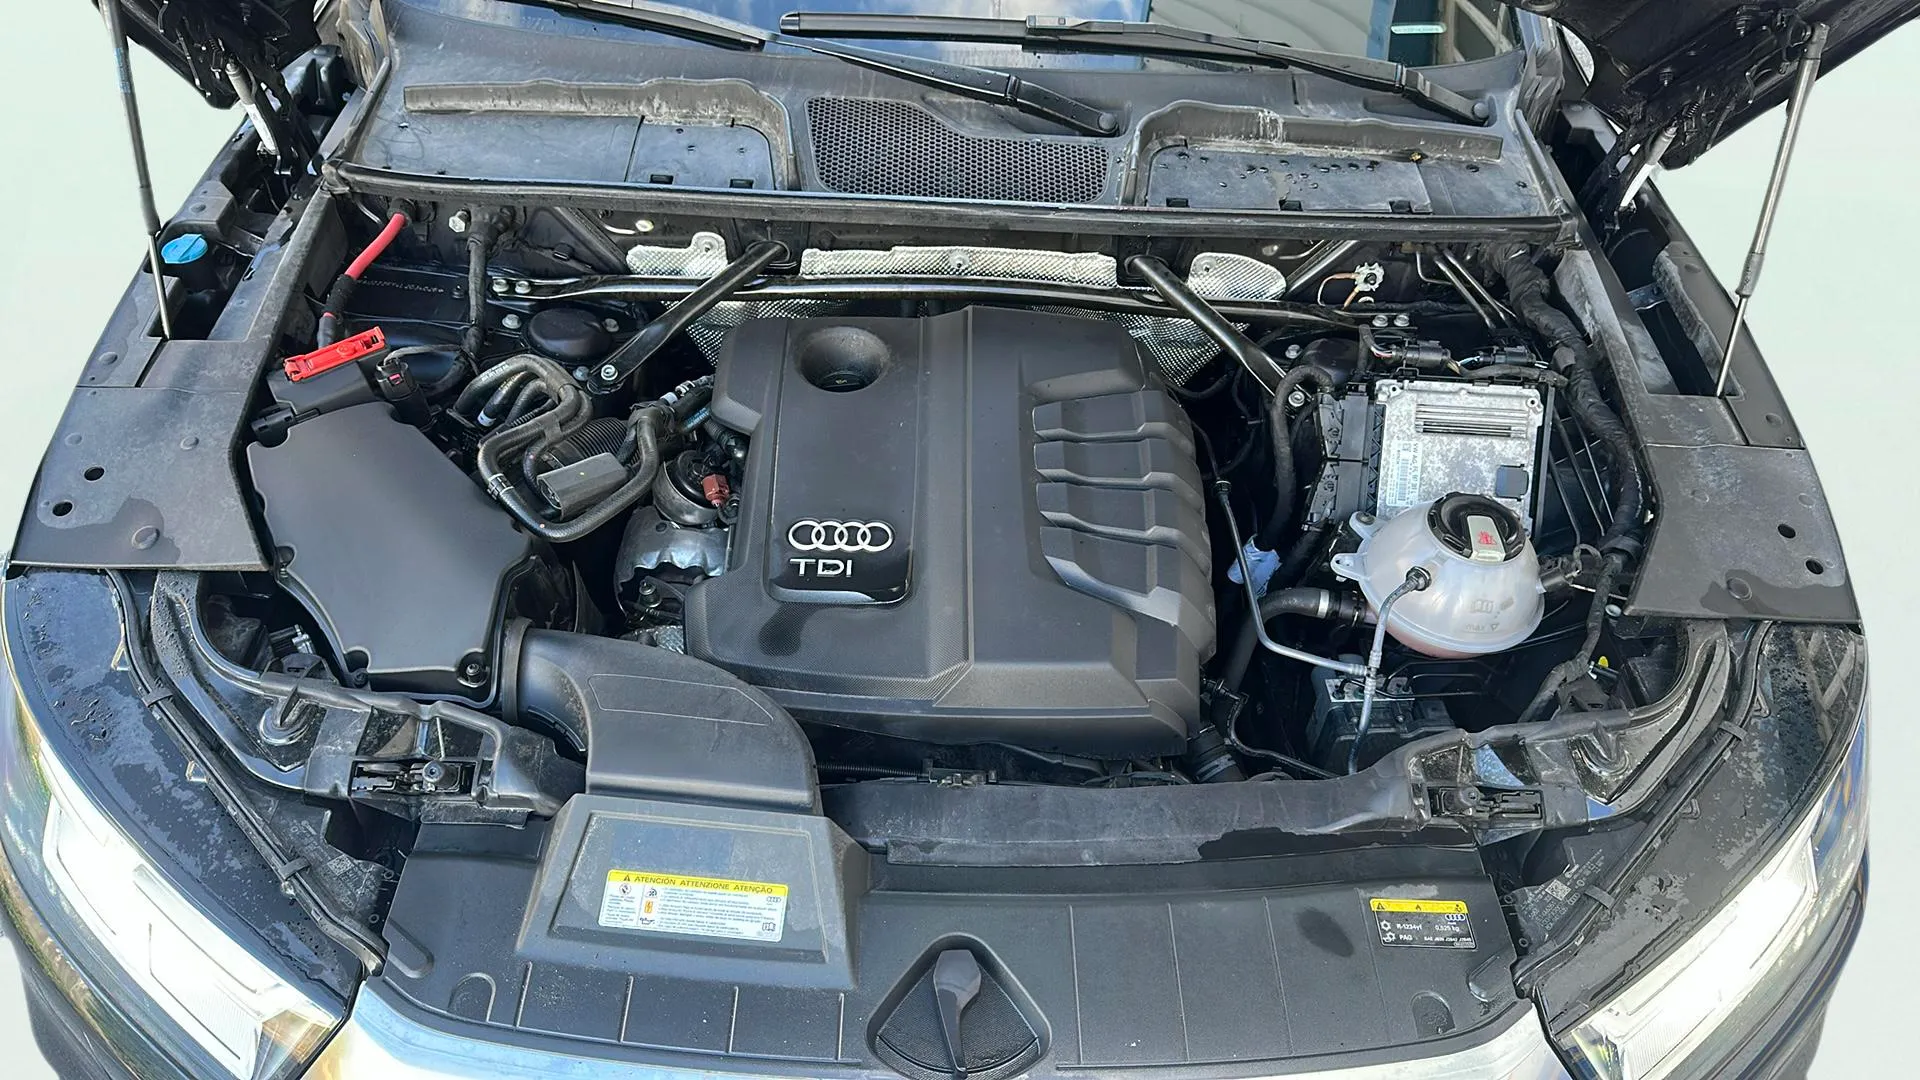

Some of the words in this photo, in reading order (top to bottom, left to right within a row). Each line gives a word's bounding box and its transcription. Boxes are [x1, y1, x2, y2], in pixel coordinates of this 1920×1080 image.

[789, 558, 853, 578] TDI
[634, 876, 676, 886] ATENCIÓN
[679, 879, 730, 891] ATTENZIONE
[733, 883, 773, 894] ATENÇÃO
